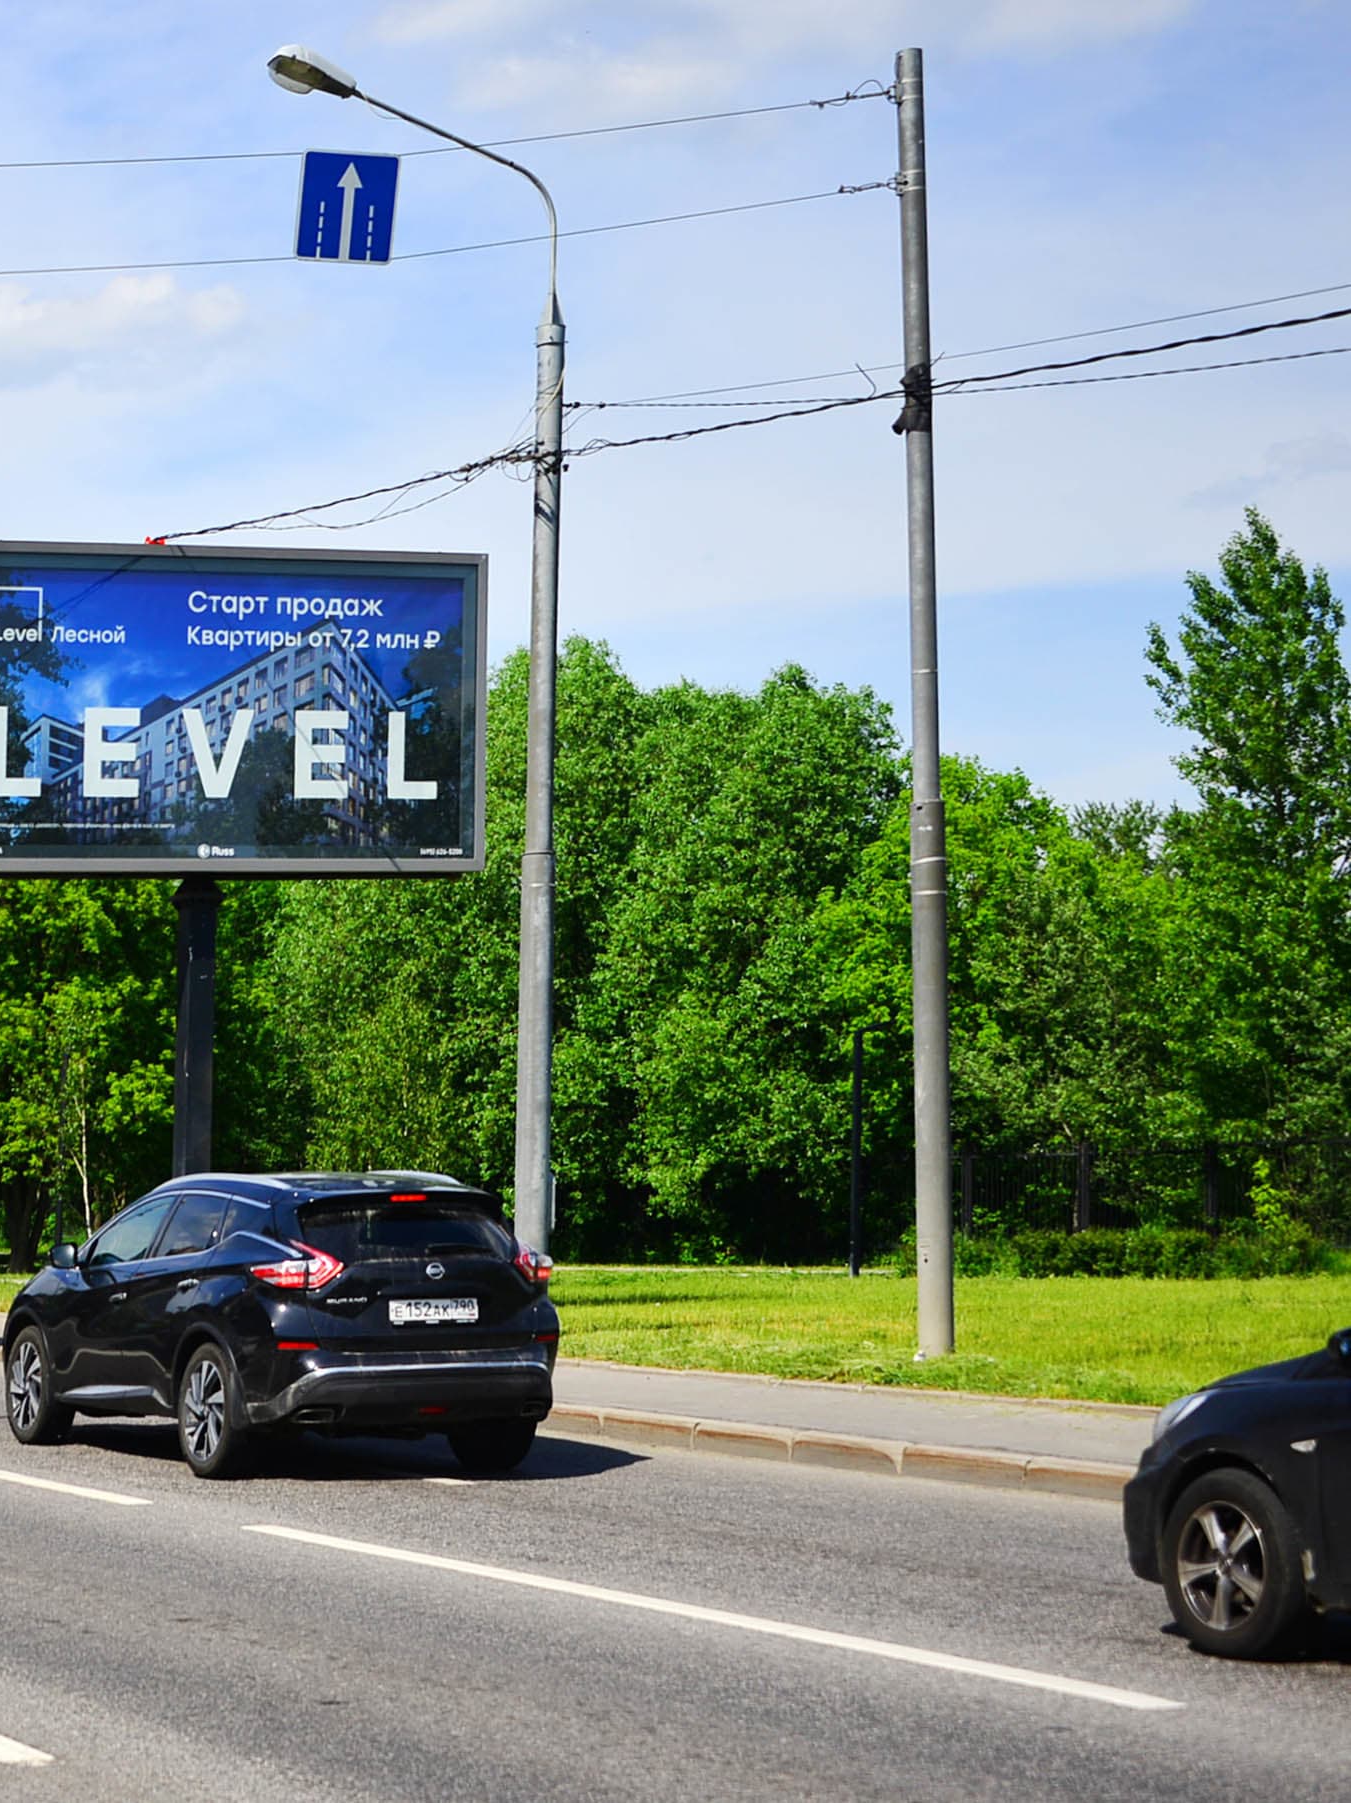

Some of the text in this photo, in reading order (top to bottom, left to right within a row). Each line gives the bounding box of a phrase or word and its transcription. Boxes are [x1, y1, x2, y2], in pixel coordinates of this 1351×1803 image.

[187, 590, 384, 622] Старт продаж
[51, 624, 127, 644] Лесной
[186, 626, 302, 652] Квартиры
[307, 631, 335, 648] от
[339, 629, 370, 651] 7,2
[375, 631, 420, 649] млн
[211, 845, 235, 857] Russ
